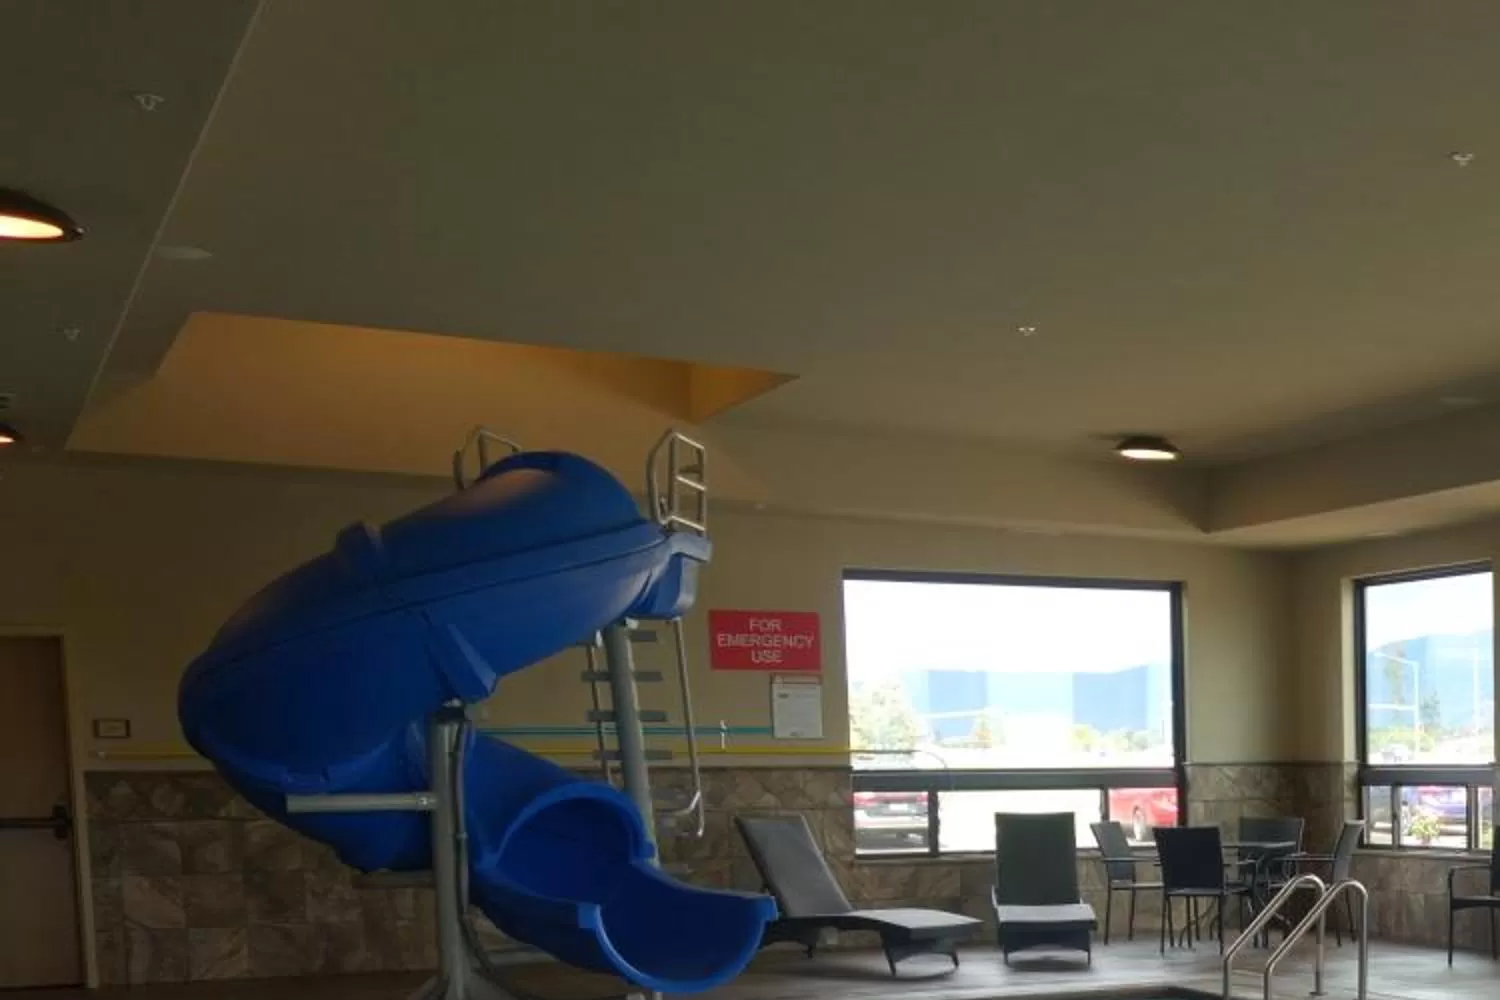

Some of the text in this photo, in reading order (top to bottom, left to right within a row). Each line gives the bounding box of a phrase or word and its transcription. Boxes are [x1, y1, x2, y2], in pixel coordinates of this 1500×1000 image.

[748, 618, 782, 632] FOR
[716, 632, 815, 649] EMERGENCY
[751, 650, 783, 664] USE
